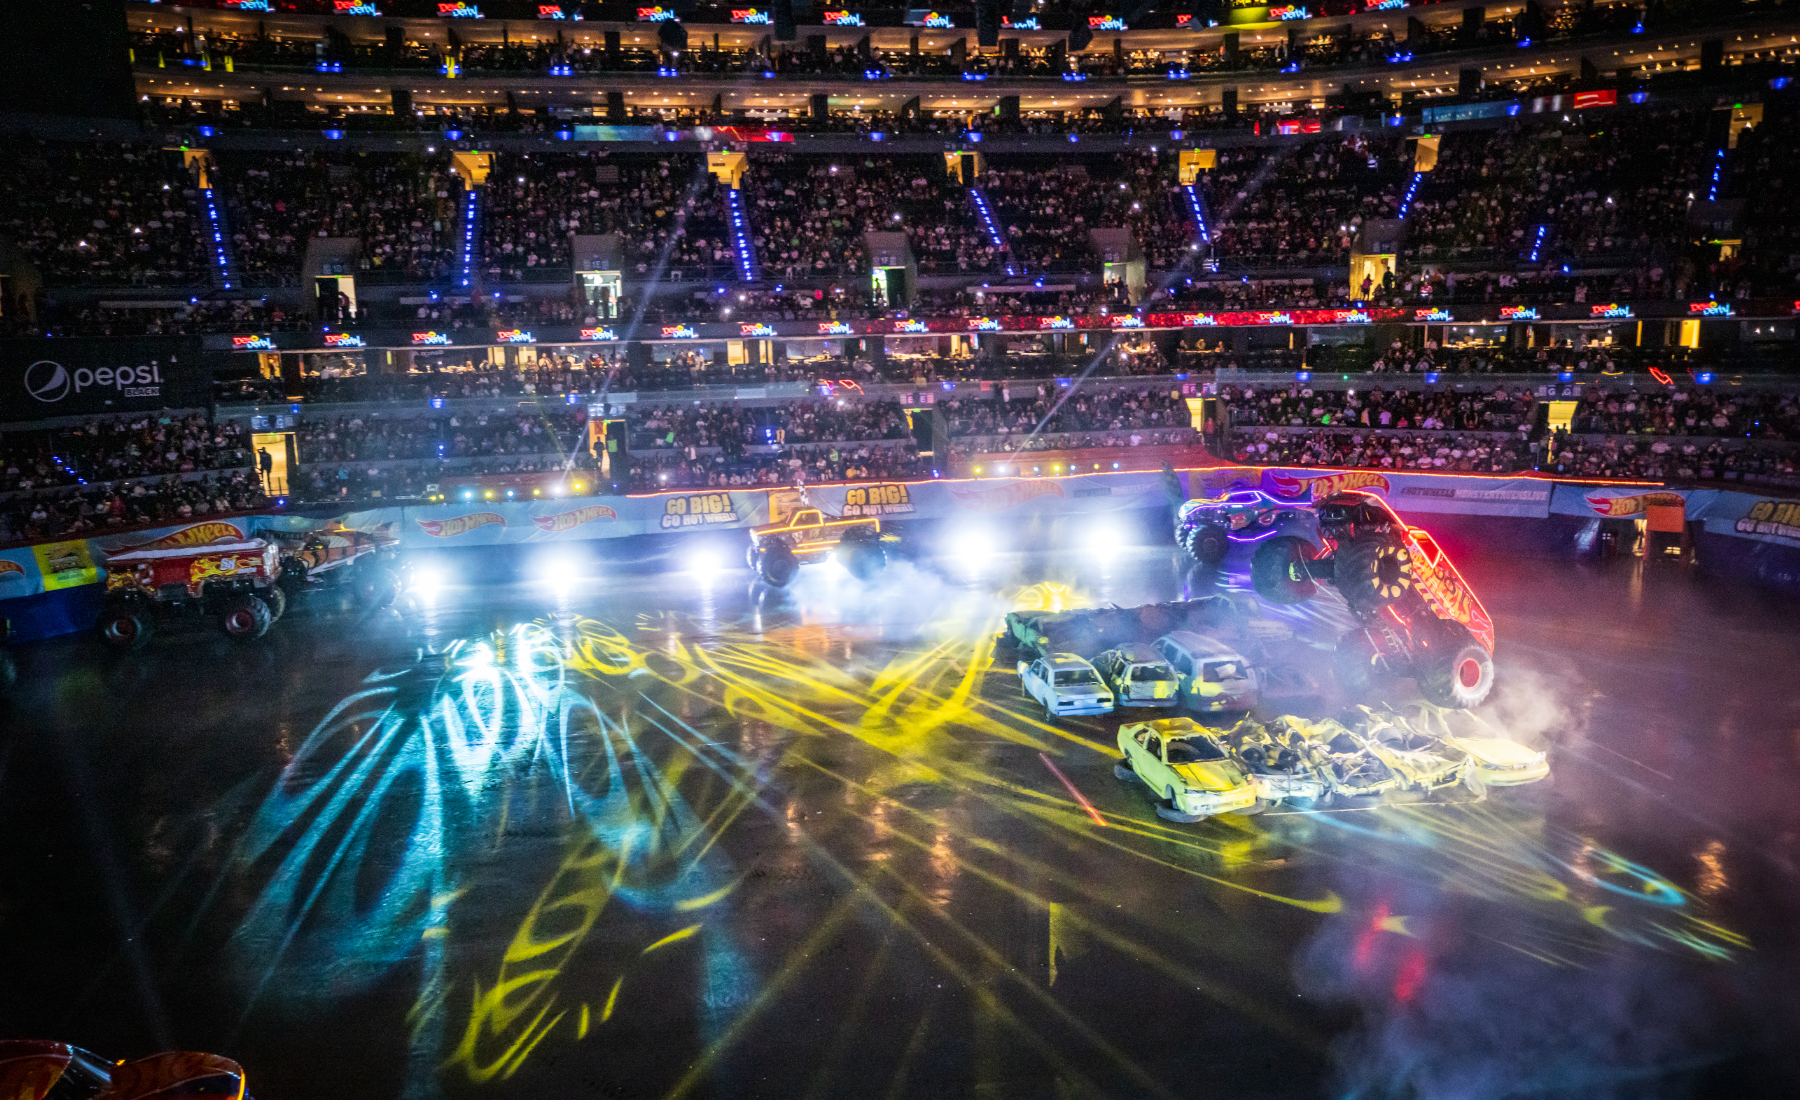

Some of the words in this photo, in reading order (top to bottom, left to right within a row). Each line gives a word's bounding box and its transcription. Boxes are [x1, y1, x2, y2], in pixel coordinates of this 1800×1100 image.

[74, 360, 159, 393] pepsi
[124, 386, 160, 397] BLACK
[847, 488, 866, 505] GO
[868, 484, 908, 504] BIG!
[667, 498, 686, 515] GO
[690, 493, 731, 514] BIG!
[843, 504, 861, 516] GO
[862, 504, 882, 516] HOT
[662, 514, 680, 528] GO
[683, 514, 703, 526] HOT
